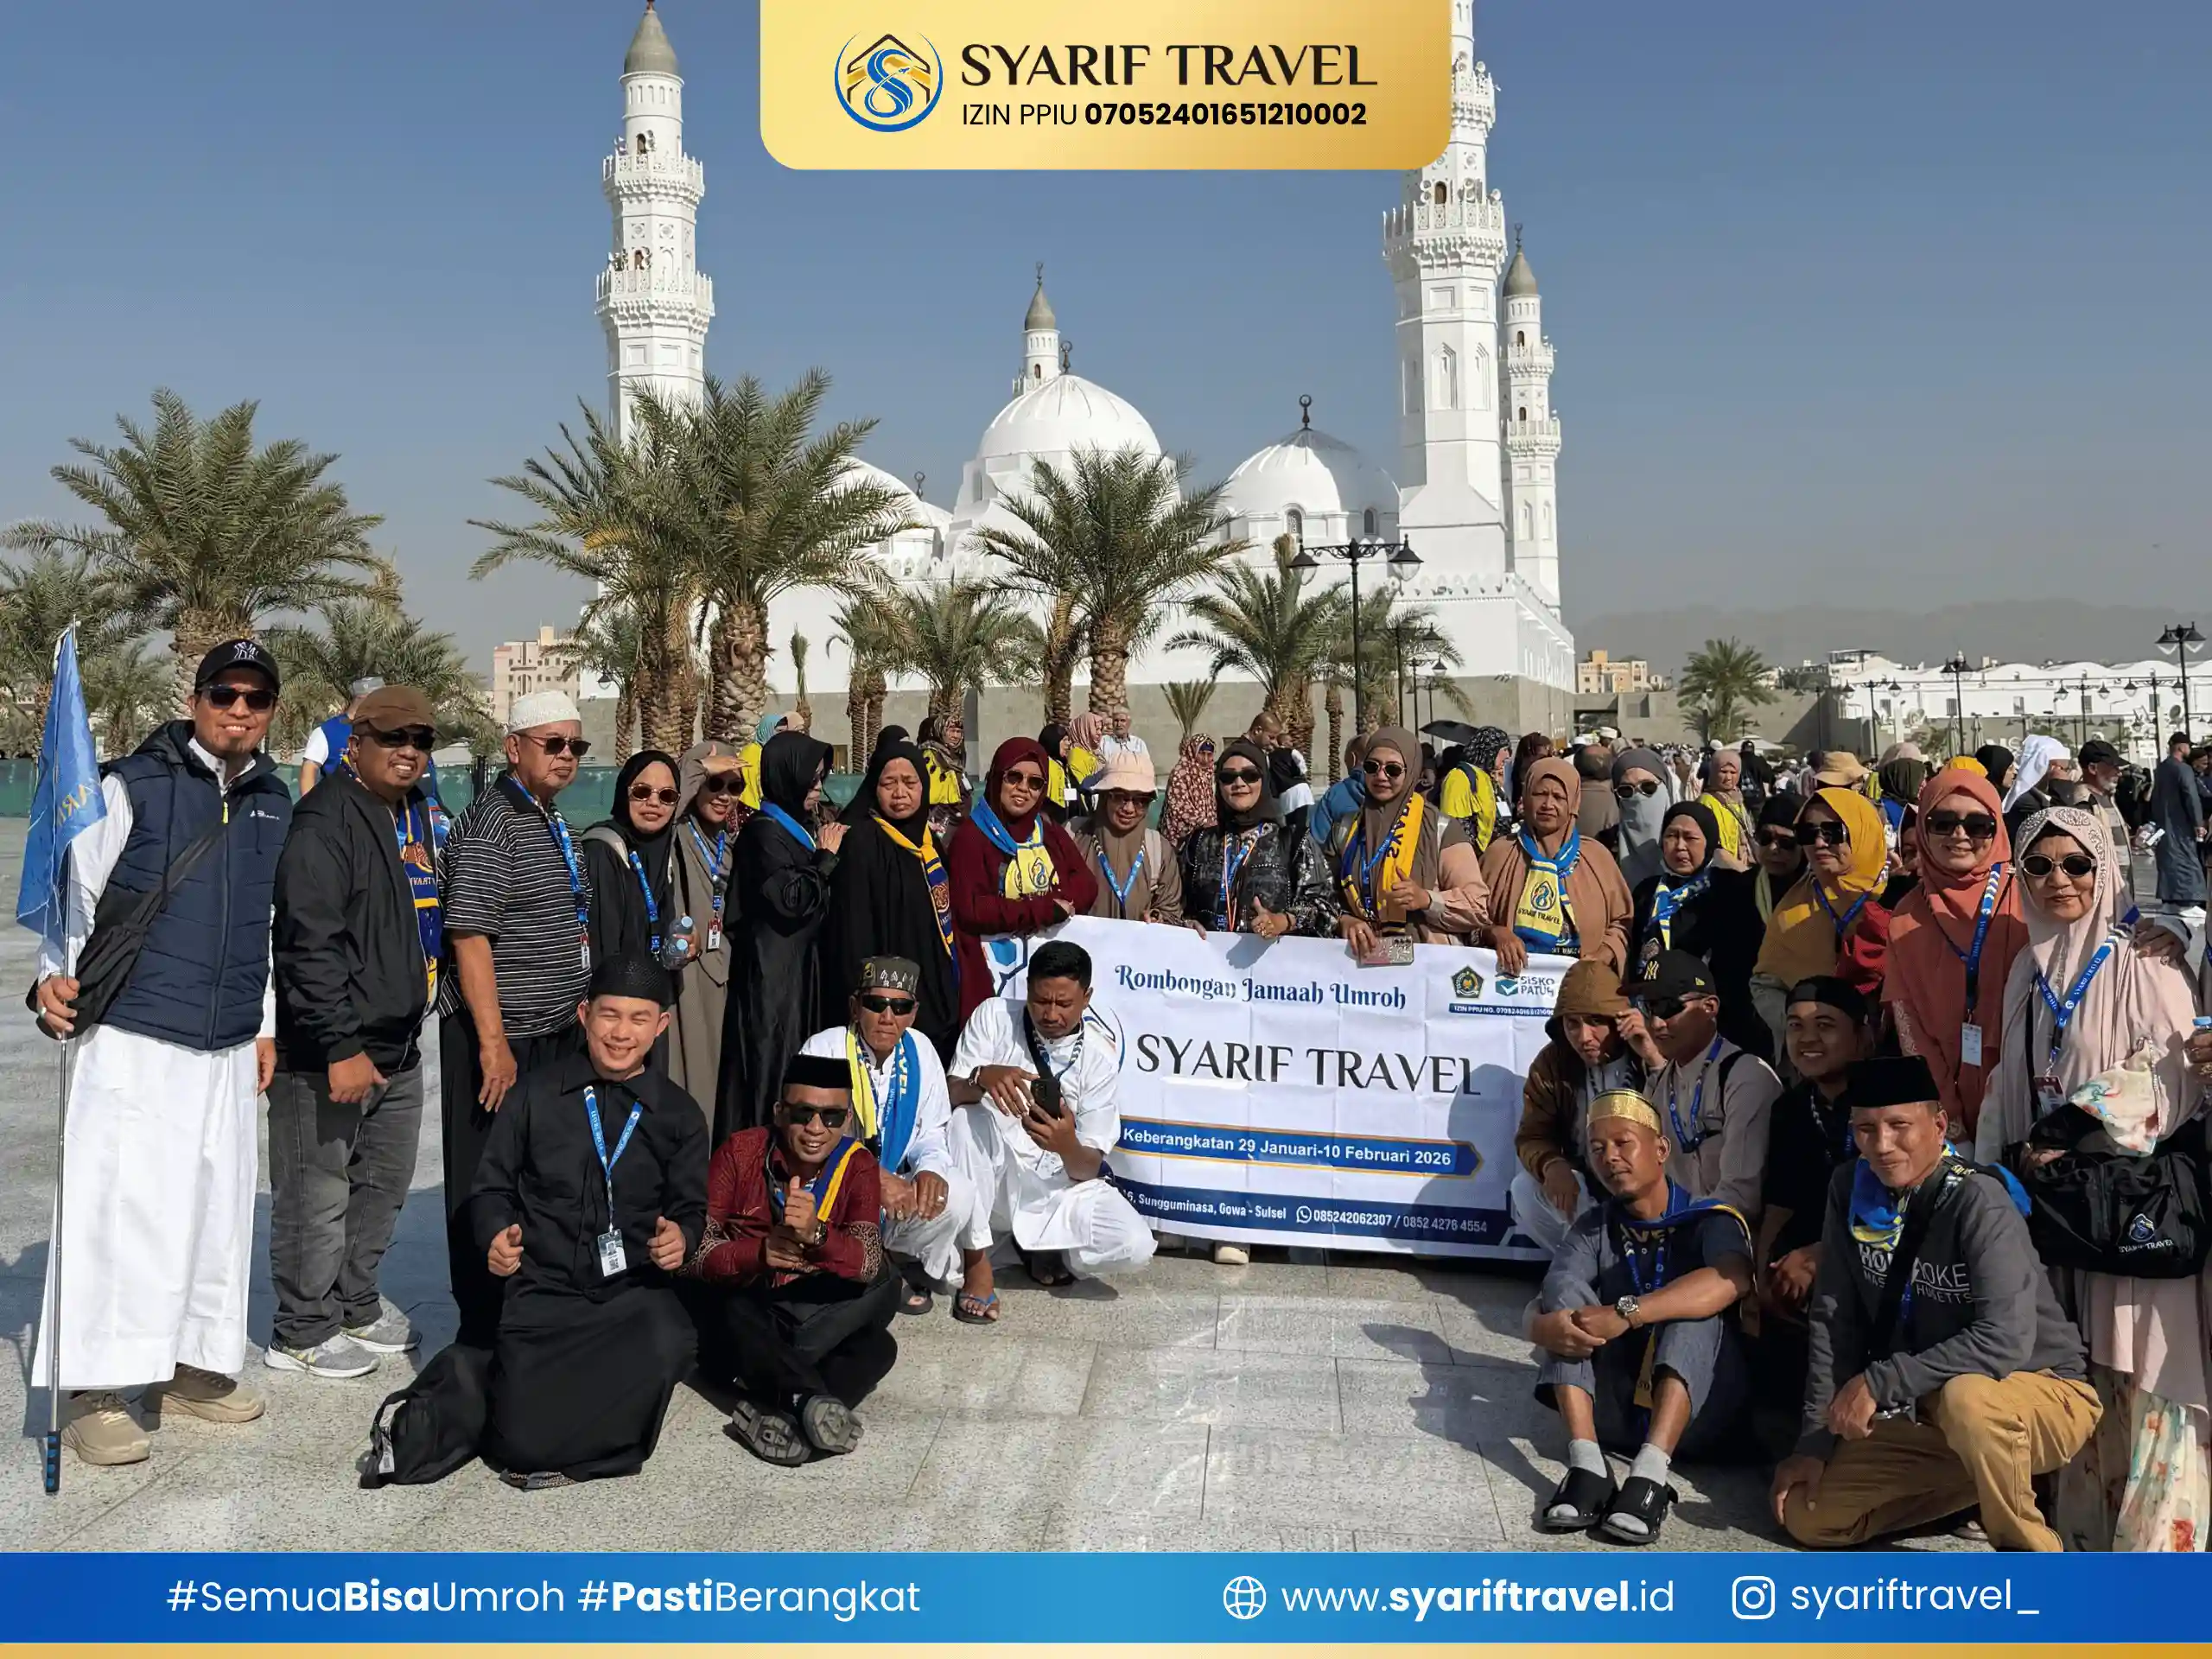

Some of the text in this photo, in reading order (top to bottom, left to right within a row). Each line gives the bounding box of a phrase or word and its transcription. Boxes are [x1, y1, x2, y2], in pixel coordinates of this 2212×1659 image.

[1538, 911, 1560, 925] TRAVEL
[1114, 964, 1407, 1010] Rombongan Jamaah Umroh
[1521, 976, 1555, 986] SISKO
[1136, 1033, 1482, 1096] SYARIF TRAVEL
[1122, 1127, 1452, 1166] Keberangkatan 29 Januari-10 Februari 2026
[1138, 1193, 1217, 1215] Sungguminasa,
[1219, 1202, 1247, 1217] Gowa
[1255, 1205, 1287, 1219] Sulsel
[1313, 1211, 1392, 1227] 085242062307
[1402, 1216, 1429, 1229] 0852
[1431, 1217, 1458, 1232] 4276
[1459, 1220, 1487, 1233] 4554
